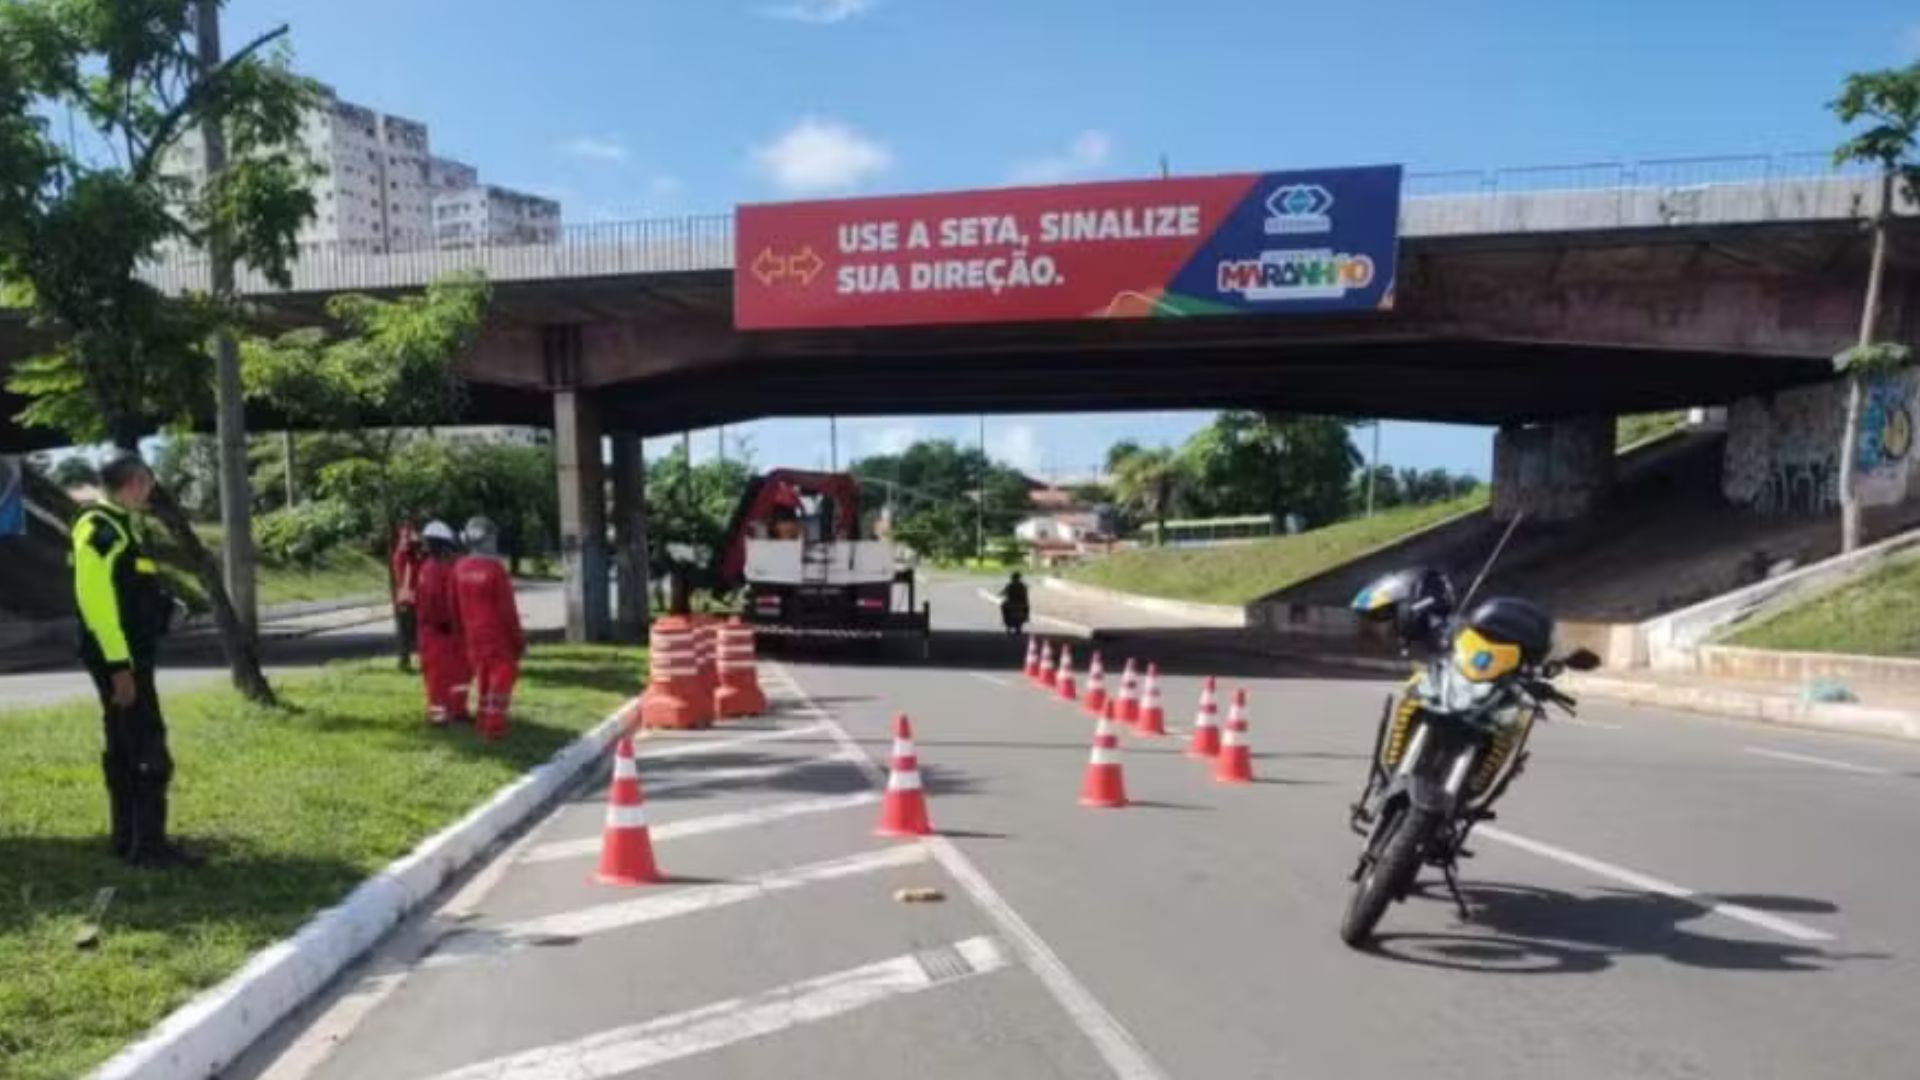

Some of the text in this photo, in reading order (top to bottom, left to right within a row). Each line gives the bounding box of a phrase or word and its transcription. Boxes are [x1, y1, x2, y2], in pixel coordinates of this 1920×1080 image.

[837, 205, 1200, 254] USE A SETA, SINALIZE
[837, 250, 1066, 296] SUA DIREÇÃO.
